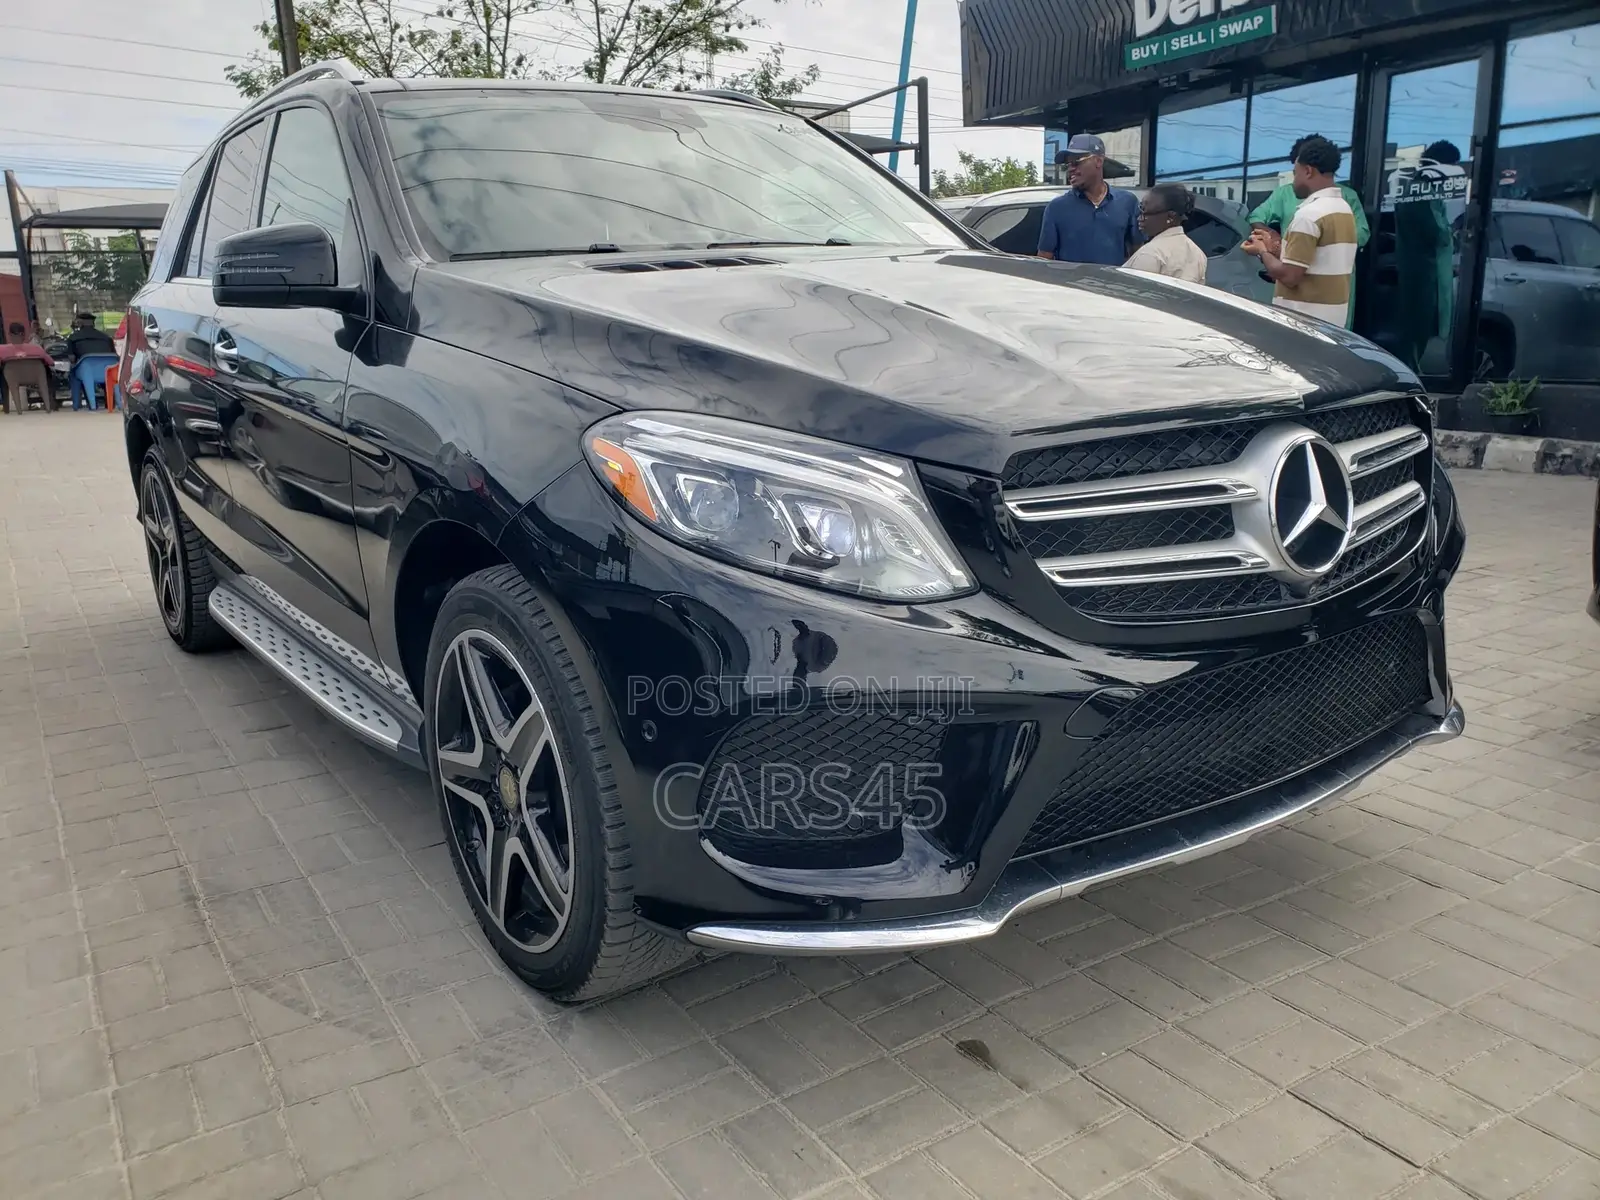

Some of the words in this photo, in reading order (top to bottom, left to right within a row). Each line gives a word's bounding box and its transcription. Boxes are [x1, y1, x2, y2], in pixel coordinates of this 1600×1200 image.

[1131, 43, 1160, 61] BUY
[1170, 31, 1207, 51] SELL
[1218, 15, 1264, 39] SWAP
